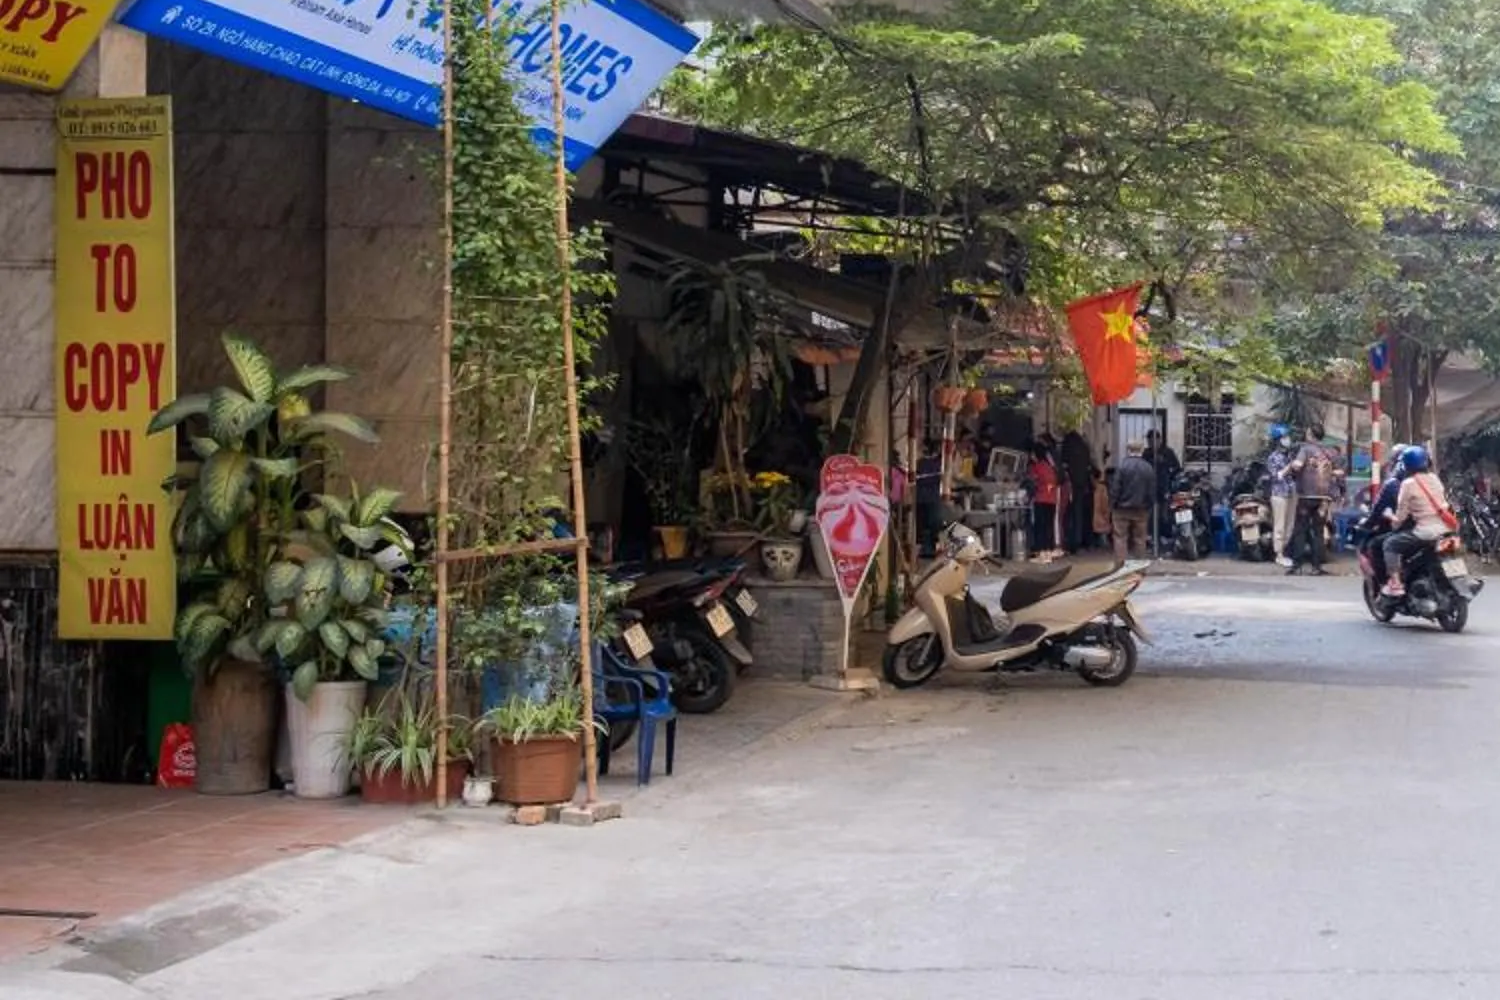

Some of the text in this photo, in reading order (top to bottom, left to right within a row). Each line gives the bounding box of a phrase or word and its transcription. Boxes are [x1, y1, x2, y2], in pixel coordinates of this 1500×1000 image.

[76, 151, 151, 219] PHO
[91, 243, 137, 312] TO
[64, 342, 165, 413] COPY
[101, 430, 131, 475] IN
[79, 493, 155, 560] LUẬN
[88, 567, 147, 625] VĂN
